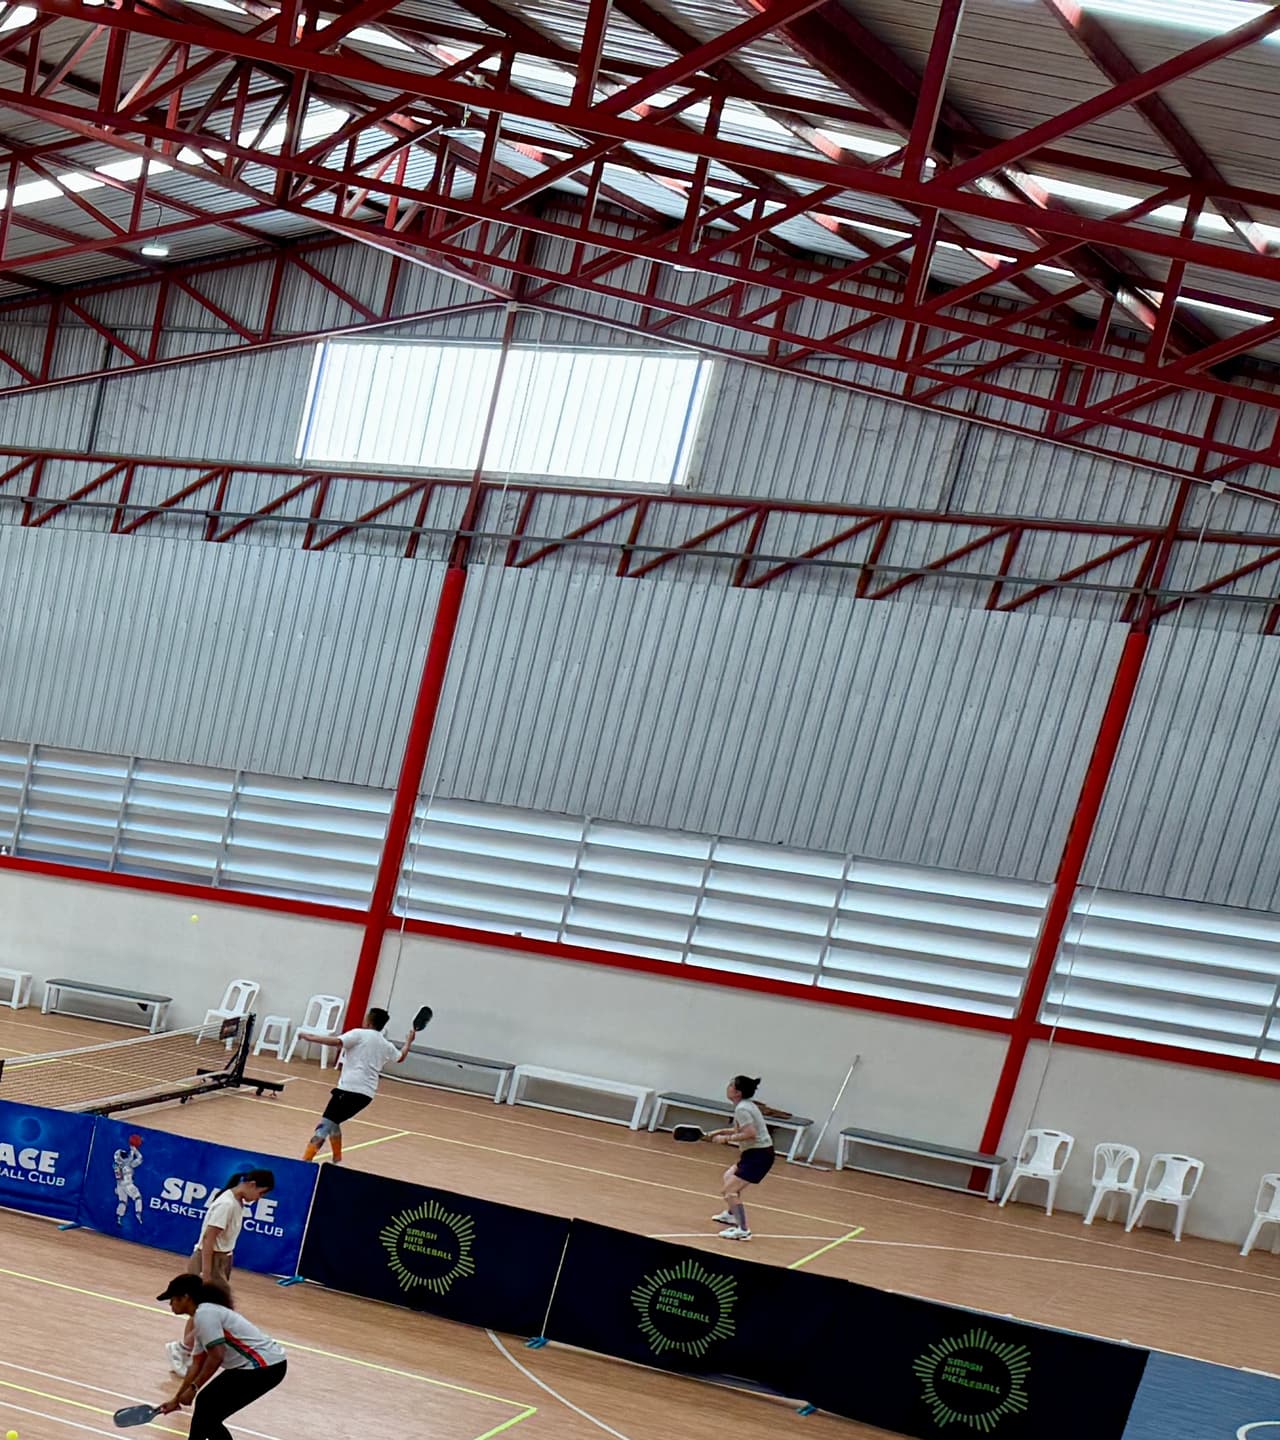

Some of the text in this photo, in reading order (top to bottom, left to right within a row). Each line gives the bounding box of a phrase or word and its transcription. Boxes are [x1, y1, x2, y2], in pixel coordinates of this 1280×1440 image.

[28, 1171, 66, 1187] CLUB
[149, 1197, 284, 1237] BASKET CLUB
